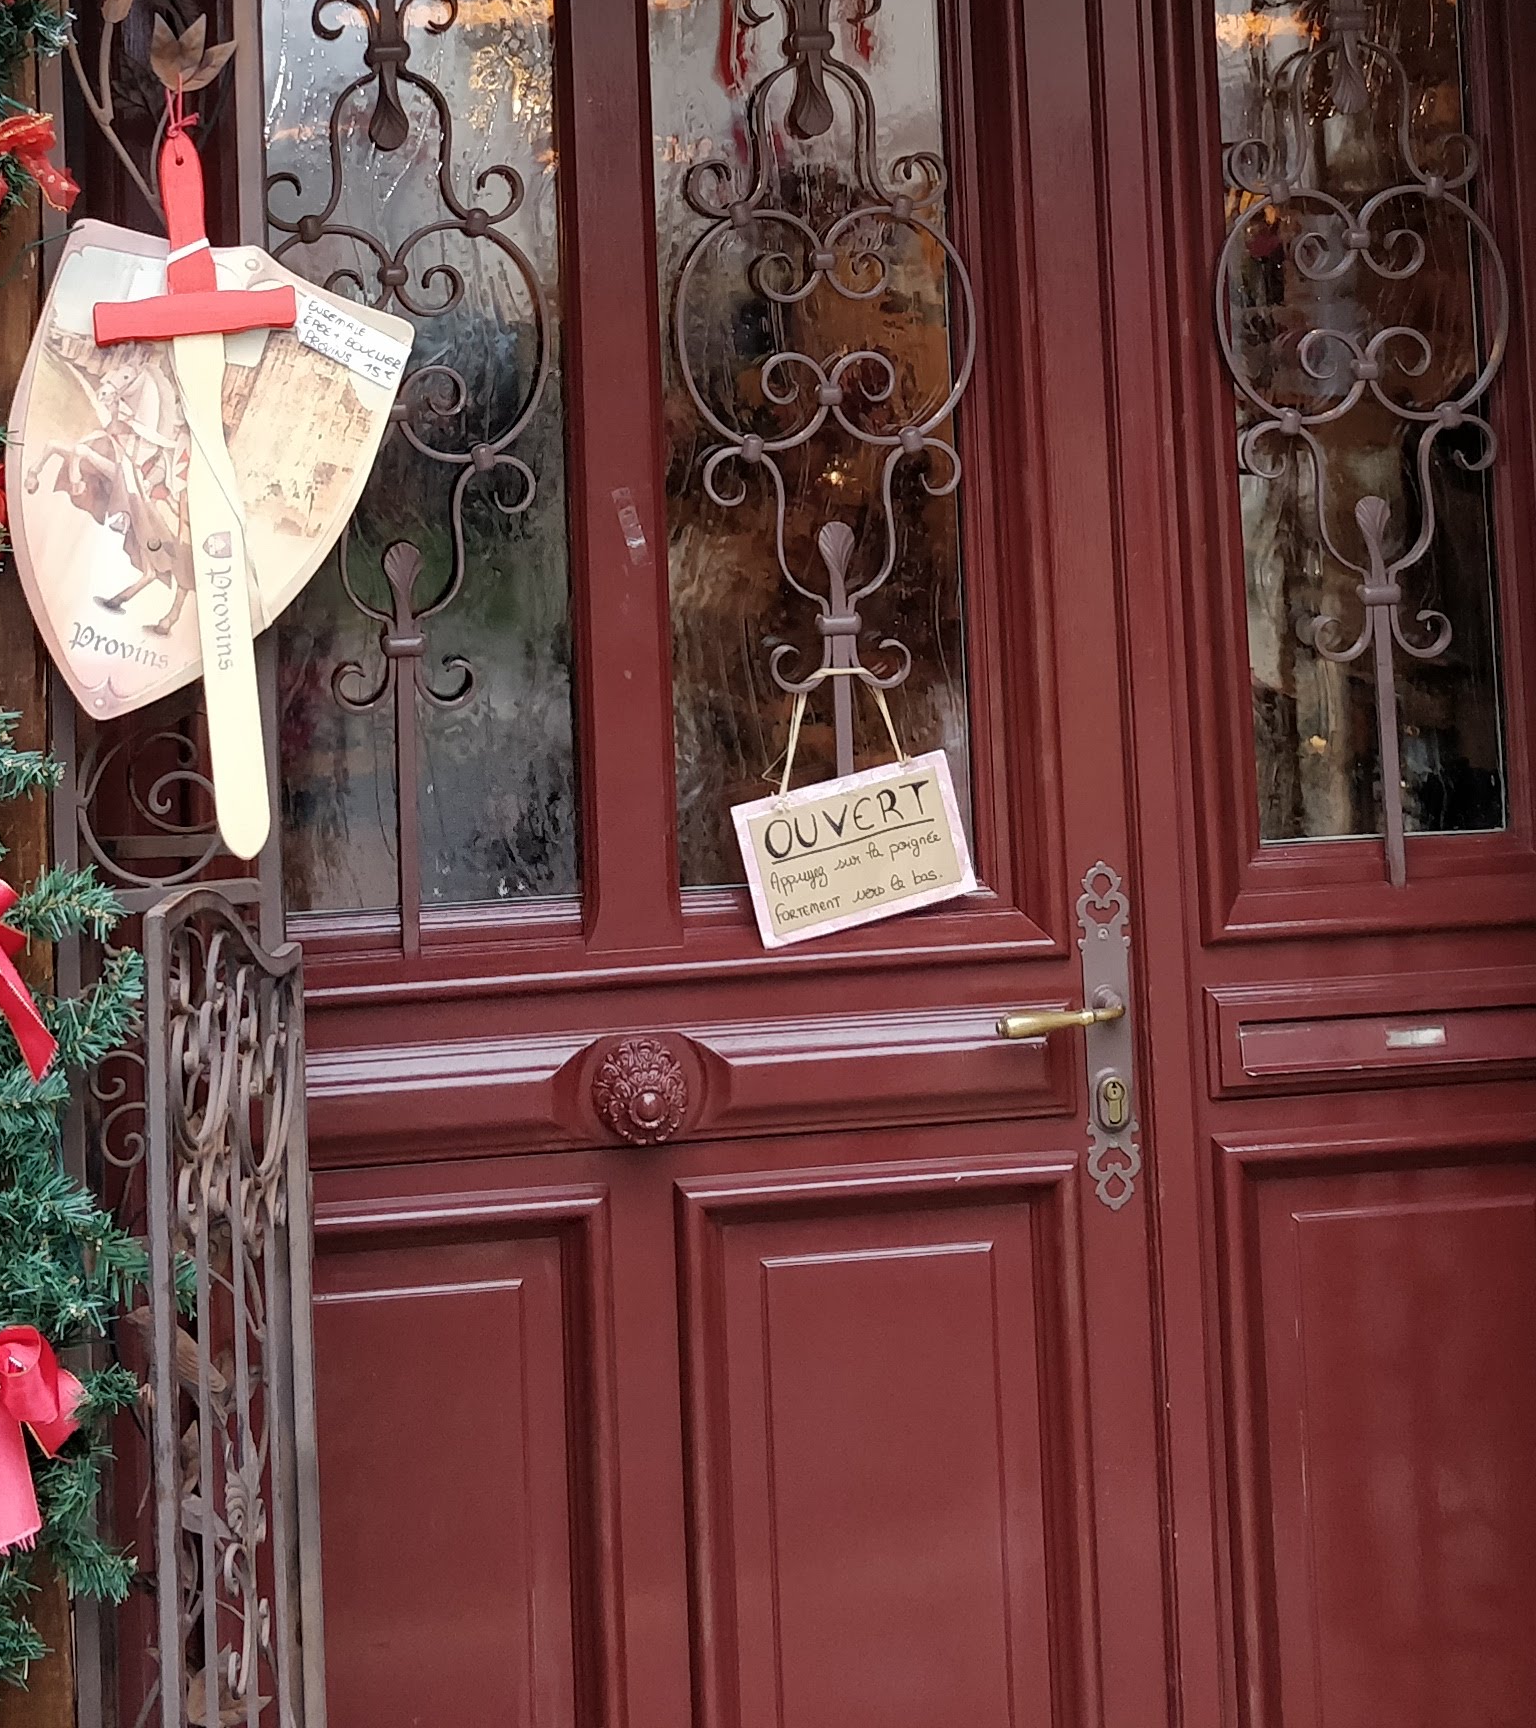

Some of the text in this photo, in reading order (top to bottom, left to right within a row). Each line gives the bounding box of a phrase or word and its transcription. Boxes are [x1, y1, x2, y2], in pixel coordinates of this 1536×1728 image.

[68, 621, 170, 670] Provins
[205, 565, 234, 671] Provins
[764, 780, 929, 860] OUVERT
[770, 865, 828, 896] Appuyez
[834, 854, 861, 871] sur
[889, 830, 942, 862] poignée
[852, 886, 886, 905] vers
